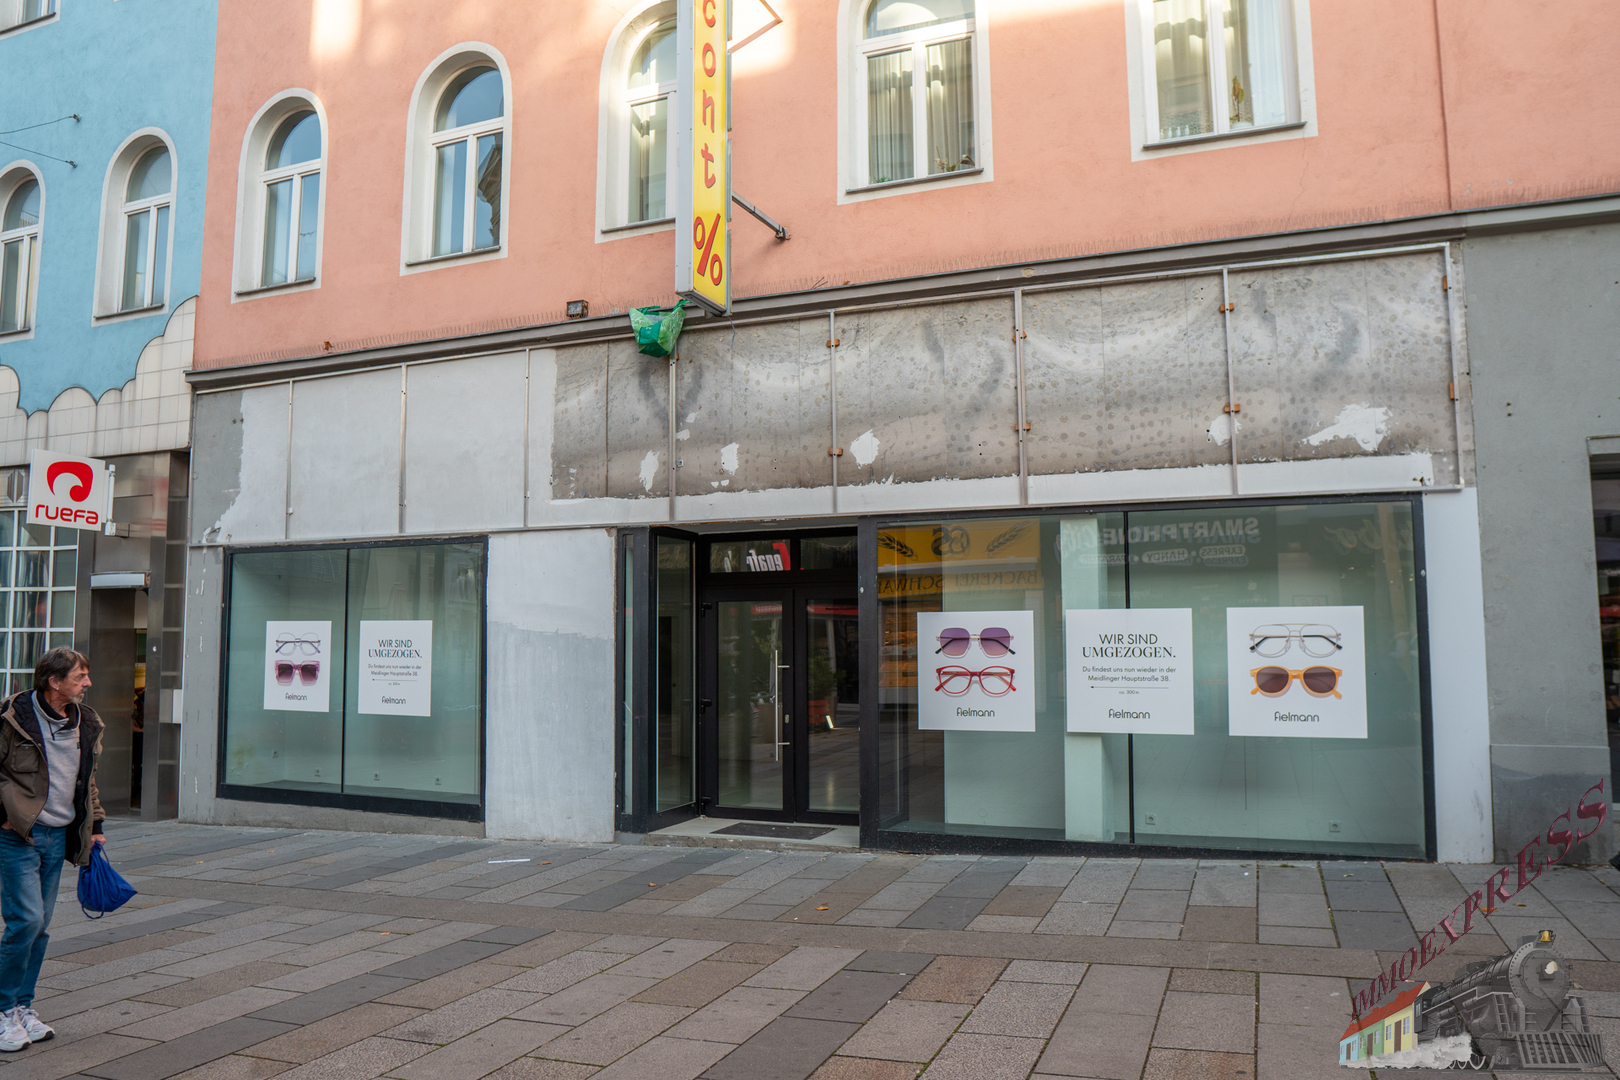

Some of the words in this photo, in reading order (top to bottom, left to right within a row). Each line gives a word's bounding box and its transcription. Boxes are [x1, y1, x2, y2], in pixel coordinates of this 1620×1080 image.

[693, 212, 723, 287] %
[36, 504, 99, 524] ruefa
[378, 639, 393, 648] WIR
[394, 639, 413, 648] SIND
[1098, 633, 1125, 645] WIR
[1127, 633, 1158, 645] SIND
[368, 648, 423, 658] UMGEZOGEN.
[1082, 646, 1176, 659] UMGEZOGEN.
[1087, 675, 1120, 683] Meidlinger
[1121, 675, 1159, 683] Hauptstraße
